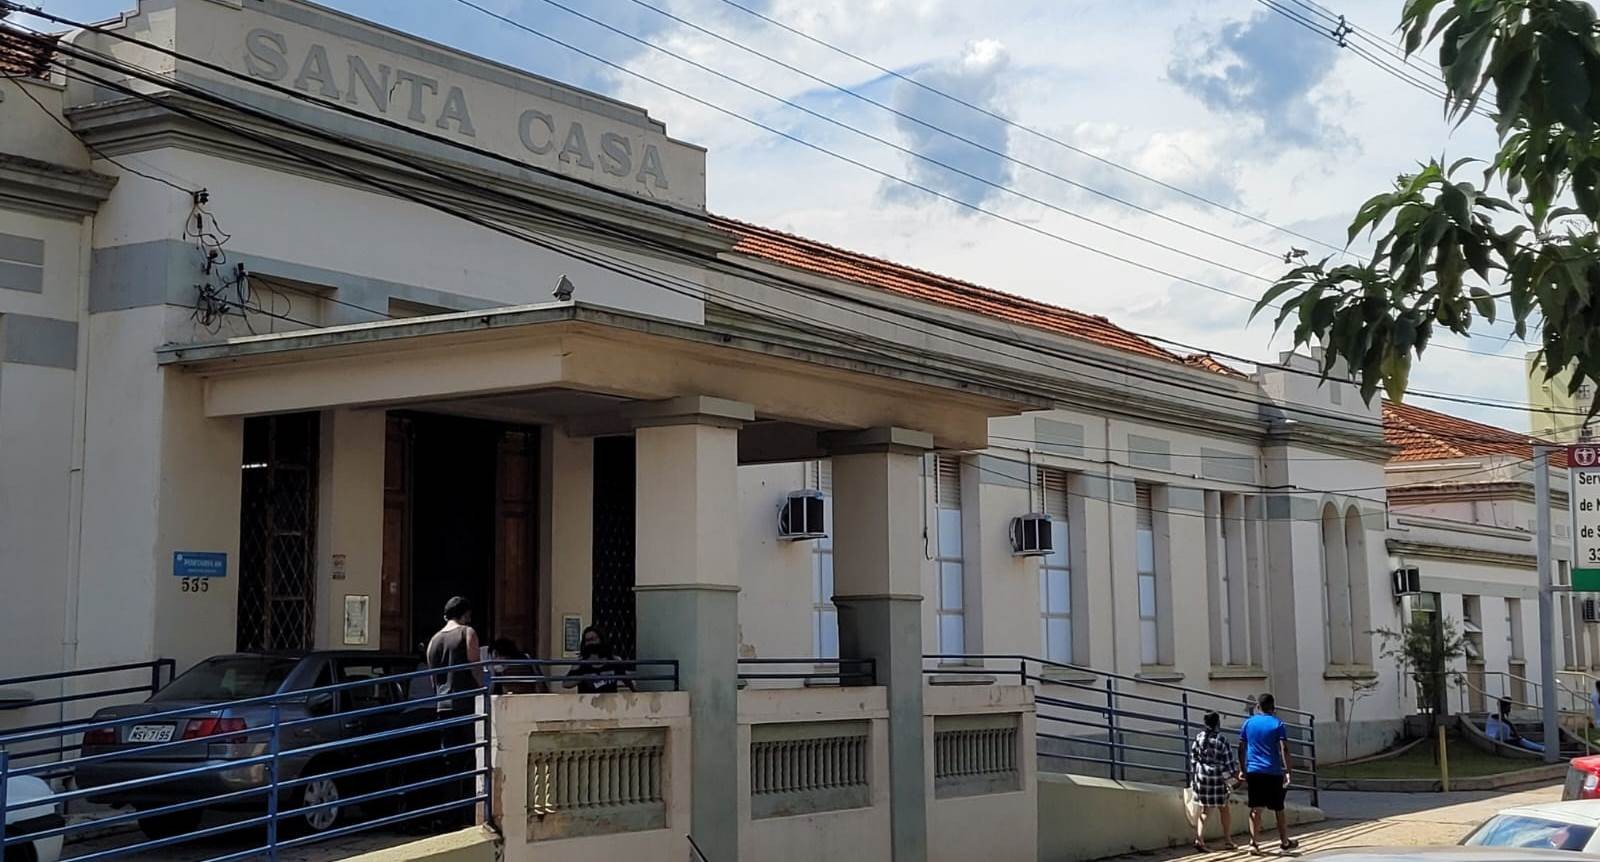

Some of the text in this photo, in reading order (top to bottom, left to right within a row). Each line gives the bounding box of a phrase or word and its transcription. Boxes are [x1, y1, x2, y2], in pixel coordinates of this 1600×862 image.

[243, 29, 669, 190] SANTA CASA
[1580, 499, 1593, 511] de
[1581, 526, 1593, 538] de
[182, 577, 208, 592] 535
